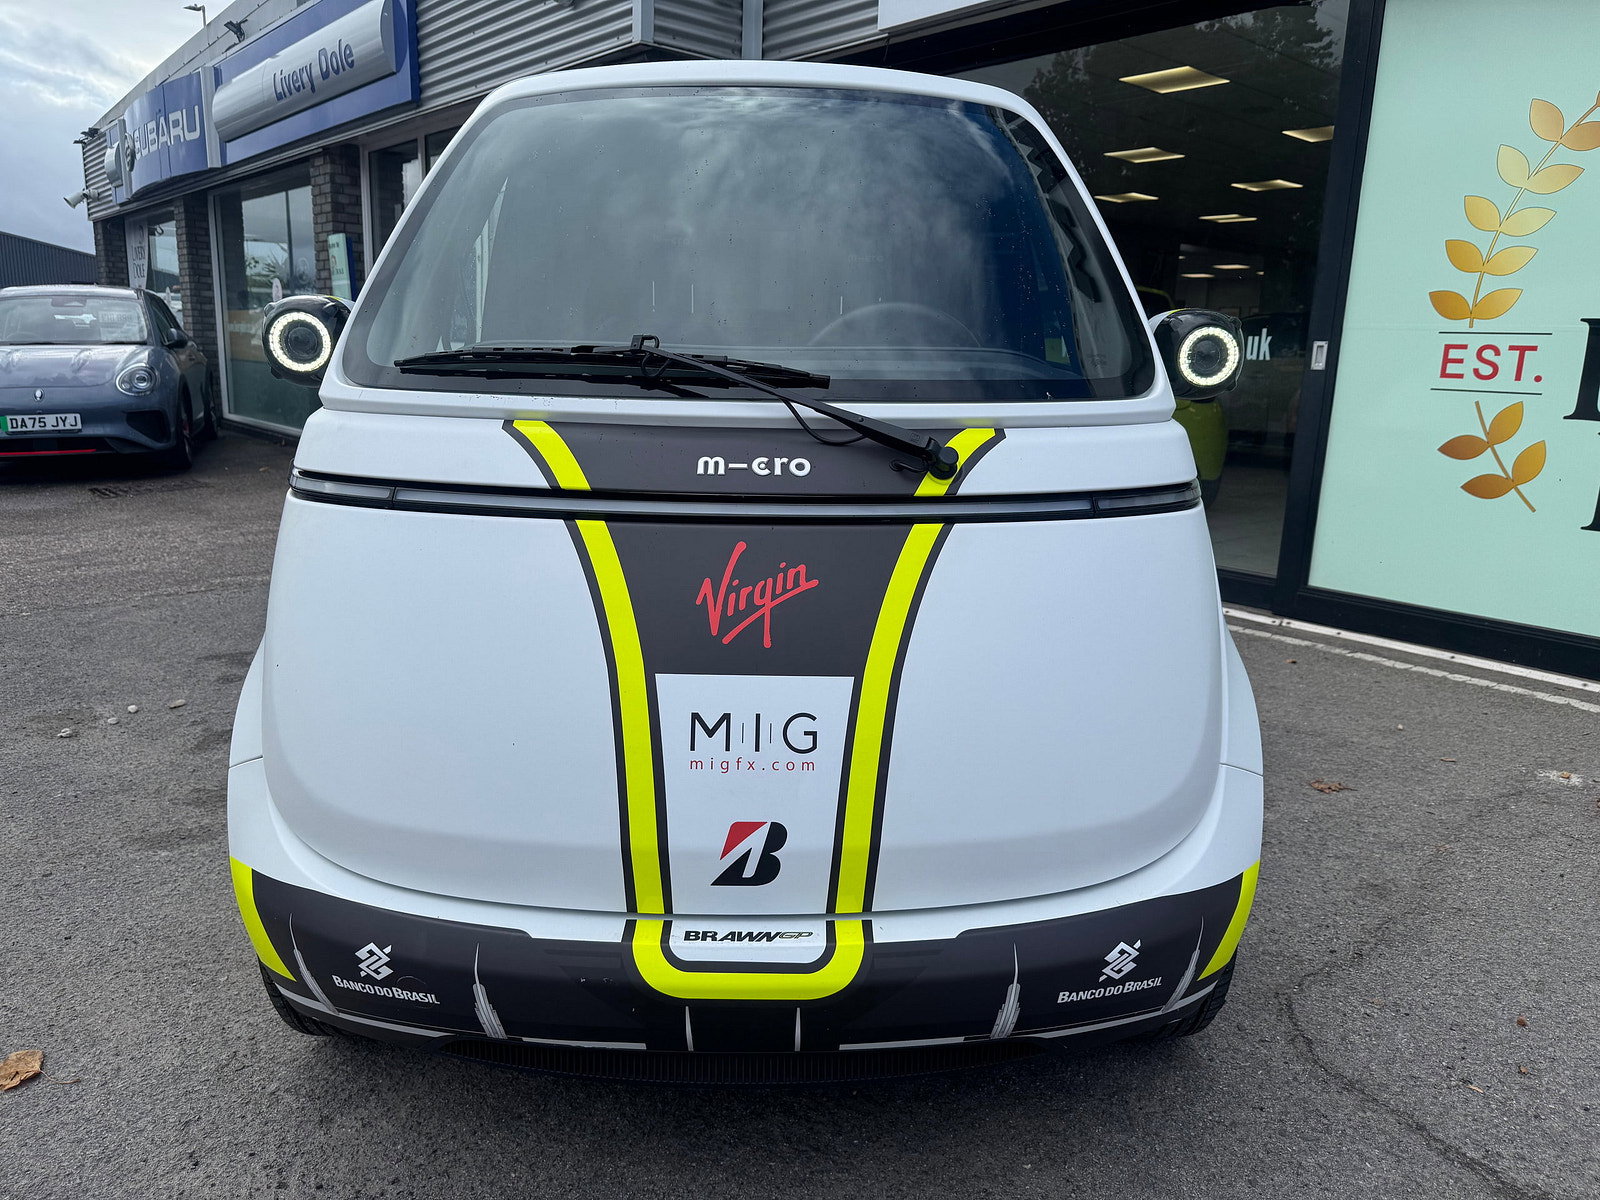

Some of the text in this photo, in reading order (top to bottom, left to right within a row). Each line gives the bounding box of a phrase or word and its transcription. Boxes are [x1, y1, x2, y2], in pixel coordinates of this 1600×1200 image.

[273, 38, 355, 101] Livery Dole
[133, 105, 201, 161] SUBARU
[1439, 343, 1543, 383] EST.
[9, 415, 78, 429] DA75 JYJ
[695, 541, 819, 649] Virgin
[689, 756, 816, 774] migfx.com
[332, 974, 441, 1005] BANCO DO BRASIL
[1057, 976, 1162, 1004] BANCO DO BRASIL
